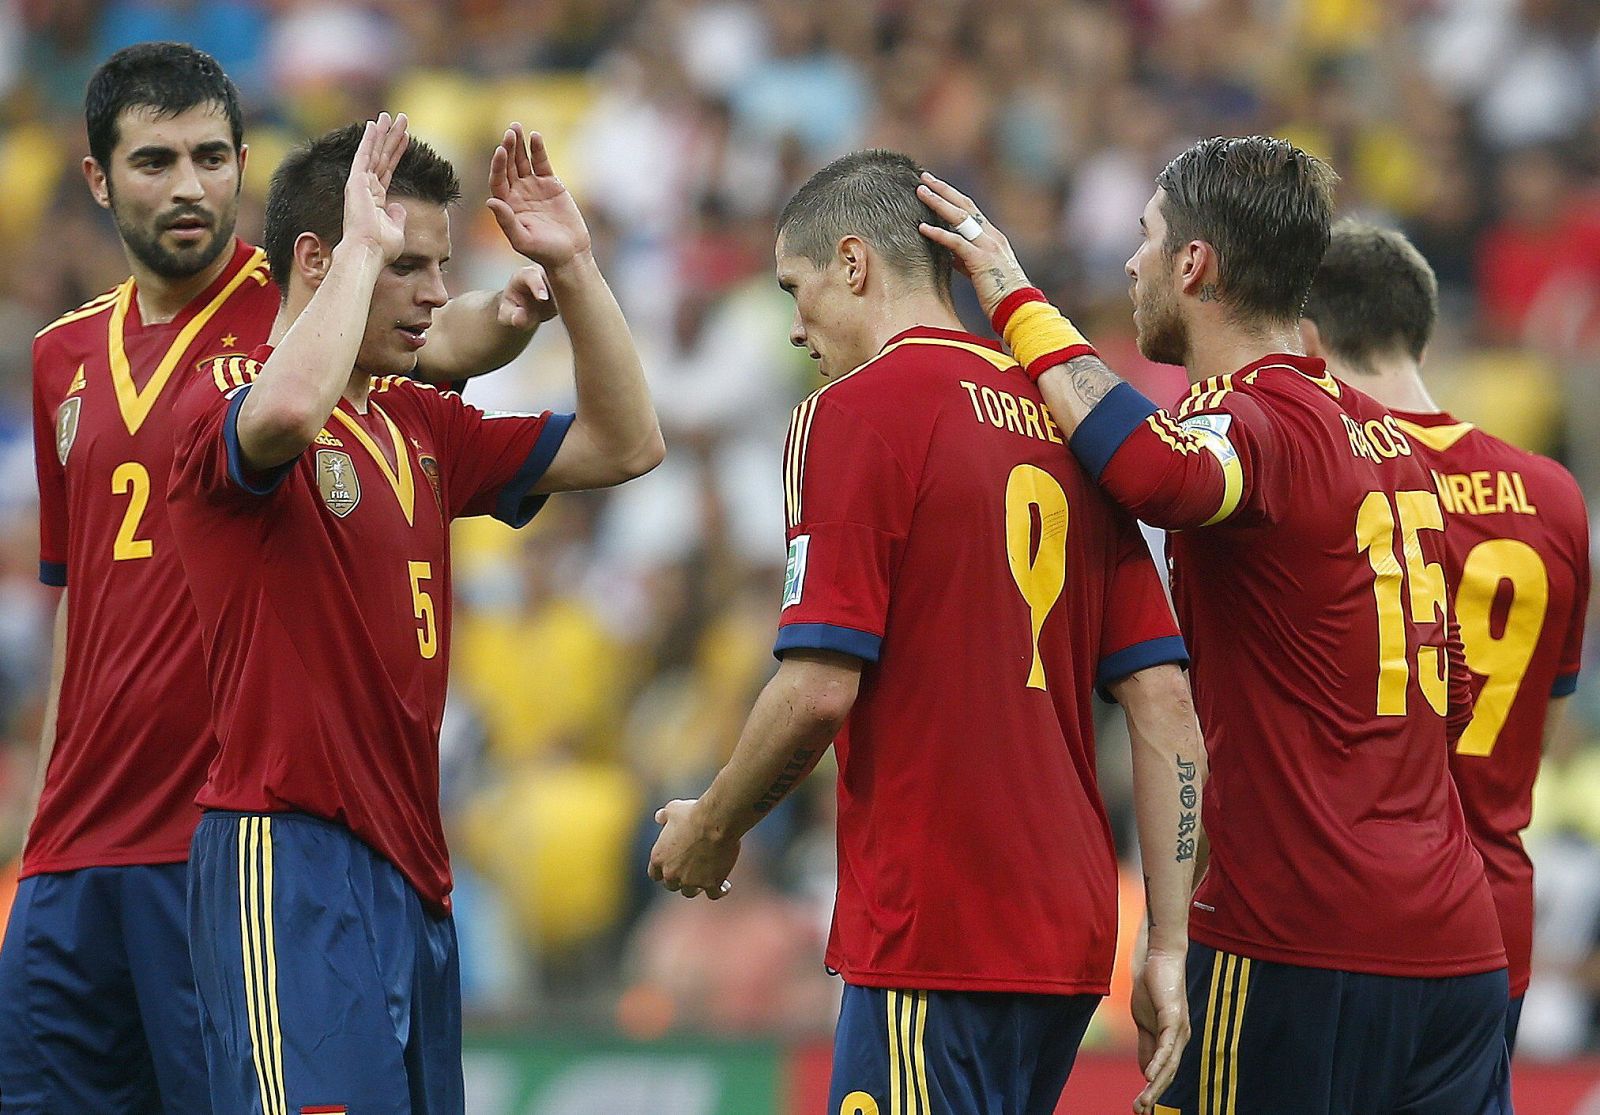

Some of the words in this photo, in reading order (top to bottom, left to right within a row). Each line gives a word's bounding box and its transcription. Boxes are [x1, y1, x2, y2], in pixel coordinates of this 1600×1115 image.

[111, 461, 154, 561] 2
[331, 490, 350, 499] FIFA
[407, 560, 438, 660] 5
[1005, 463, 1070, 692] 9
[1356, 490, 1448, 718] 15
[1453, 537, 1550, 758] 9
